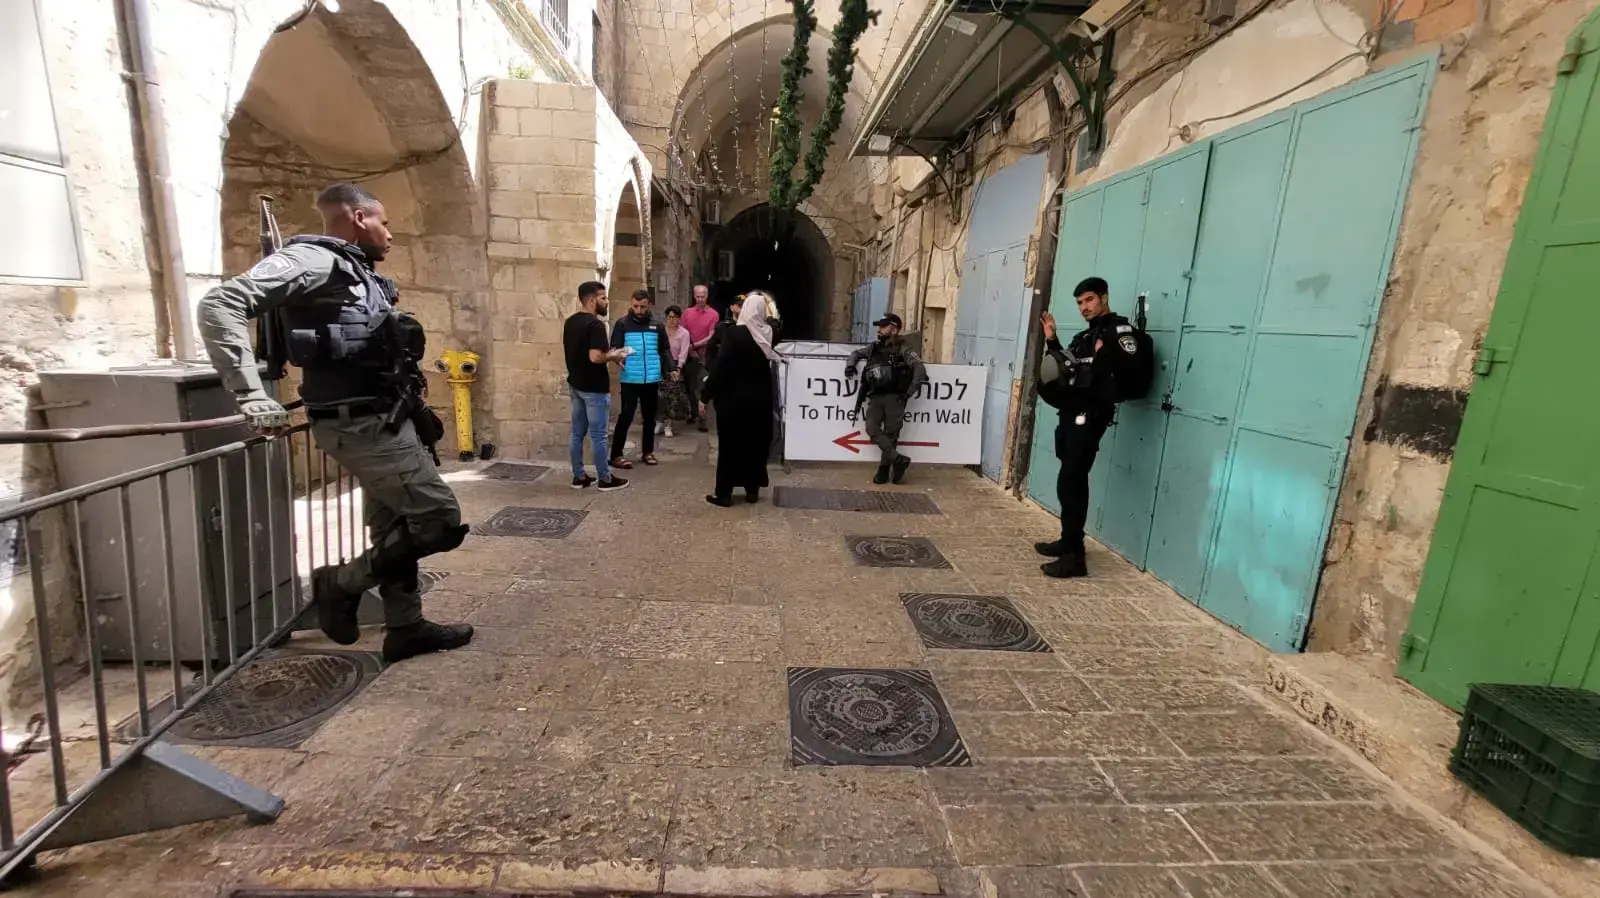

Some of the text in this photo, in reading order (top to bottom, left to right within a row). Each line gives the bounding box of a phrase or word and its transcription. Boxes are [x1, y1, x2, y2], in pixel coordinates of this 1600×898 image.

[806, 377, 968, 401] לכות ערבי
[798, 404, 819, 420] To
[824, 404, 858, 421] The
[935, 408, 971, 425] Wall
